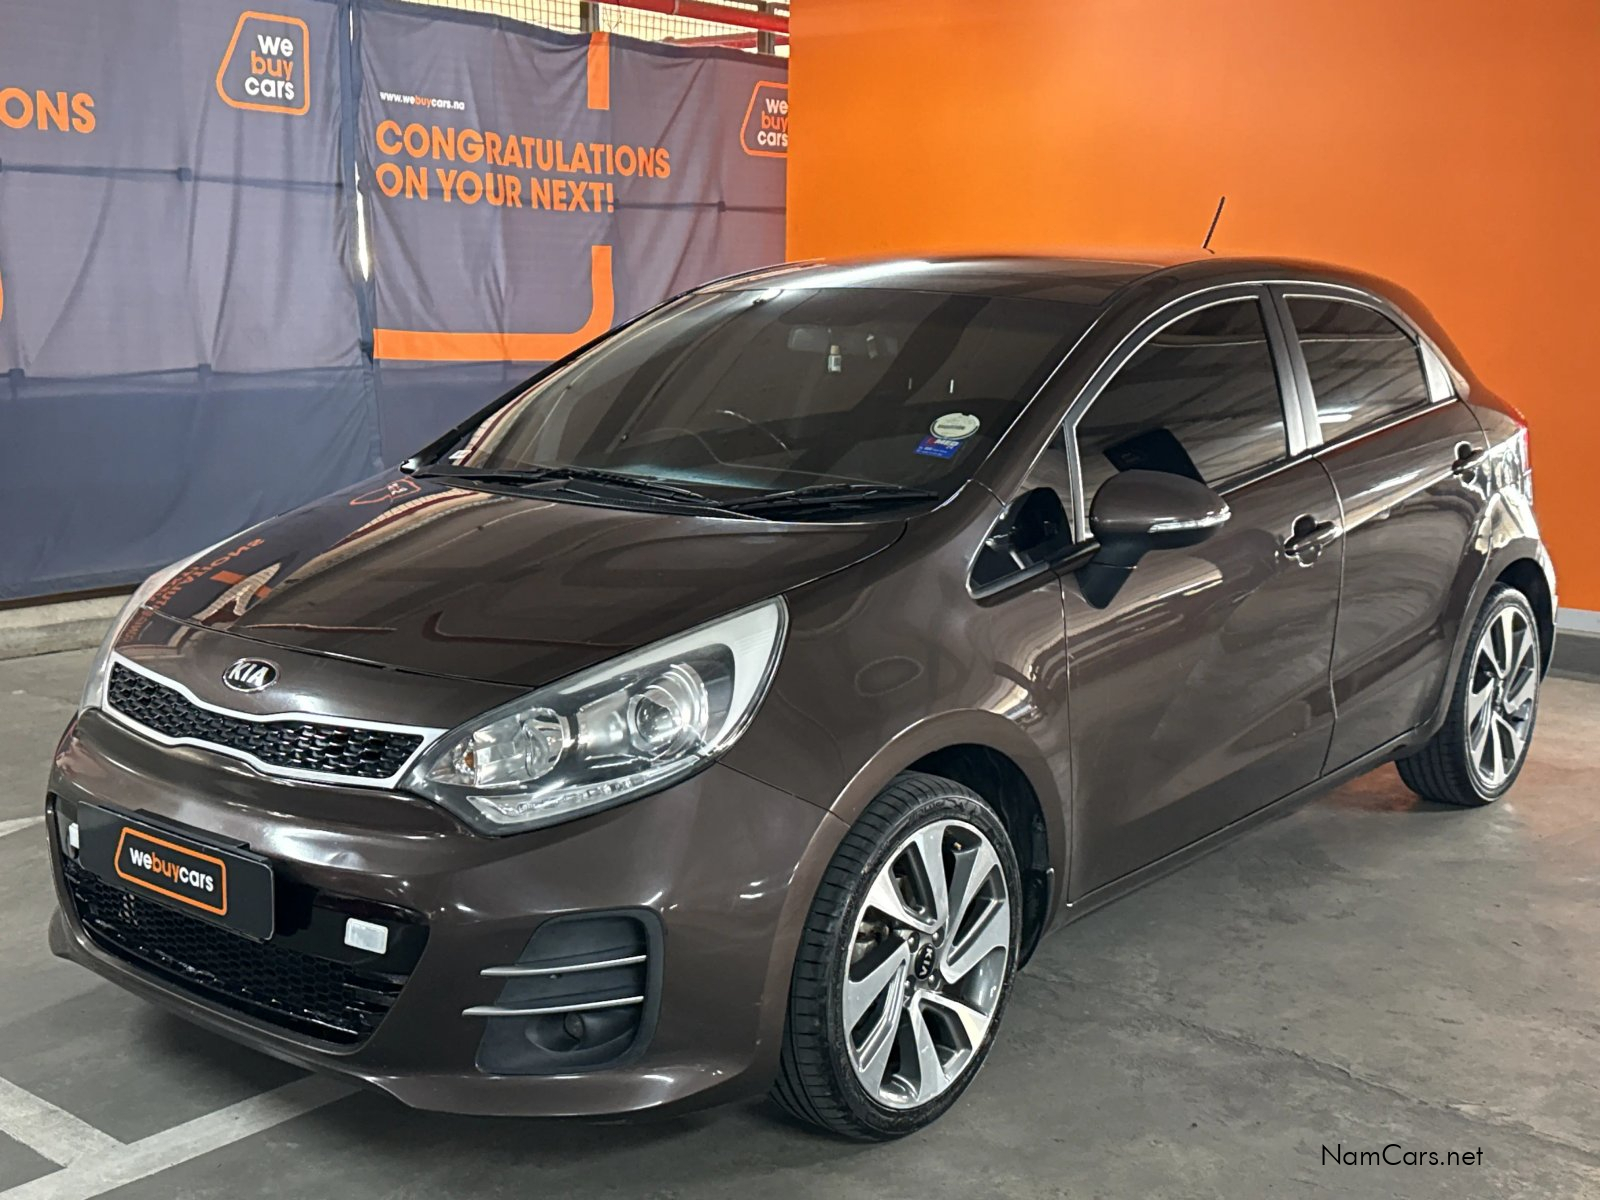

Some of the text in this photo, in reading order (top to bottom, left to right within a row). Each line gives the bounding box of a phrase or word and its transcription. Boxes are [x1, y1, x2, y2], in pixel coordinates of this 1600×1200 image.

[257, 34, 294, 57] we
[250, 50, 294, 81] buy
[244, 76, 295, 100] cars
[379, 91, 465, 111] www.webuycars.na
[0, 87, 96, 134] ONS
[765, 97, 789, 115] we
[761, 110, 789, 133] buy
[375, 119, 671, 179] CONGRATULATIONS
[757, 130, 789, 147] cars
[375, 162, 614, 213] ON YOUR NEXT!
[228, 660, 269, 687] KIA
[128, 847, 214, 892] webuycars
[919, 947, 933, 976] KIA
